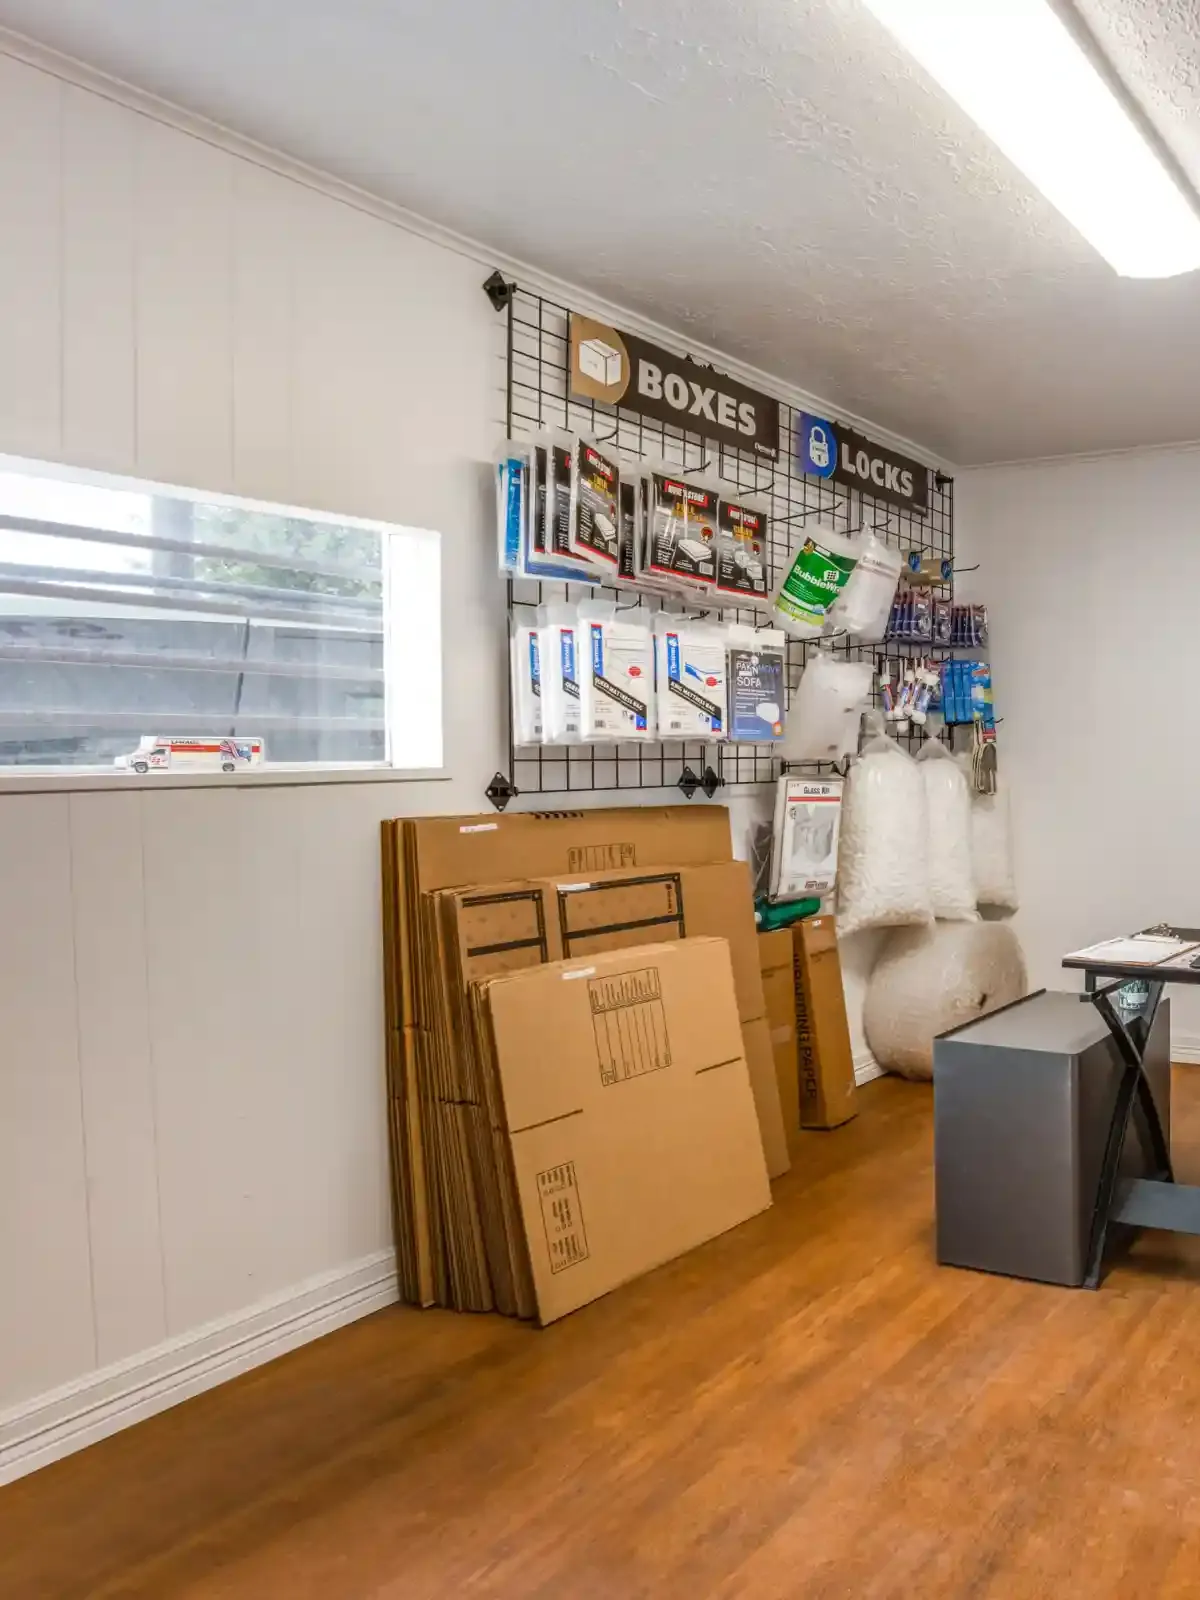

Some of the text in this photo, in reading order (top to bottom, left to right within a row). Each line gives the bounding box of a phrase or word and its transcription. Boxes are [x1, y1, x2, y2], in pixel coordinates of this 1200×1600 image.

[638, 358, 757, 436] BOXES
[841, 442, 914, 498] LOCKS
[736, 676, 762, 688] SOFA
[802, 1046, 817, 1099] PAPER
